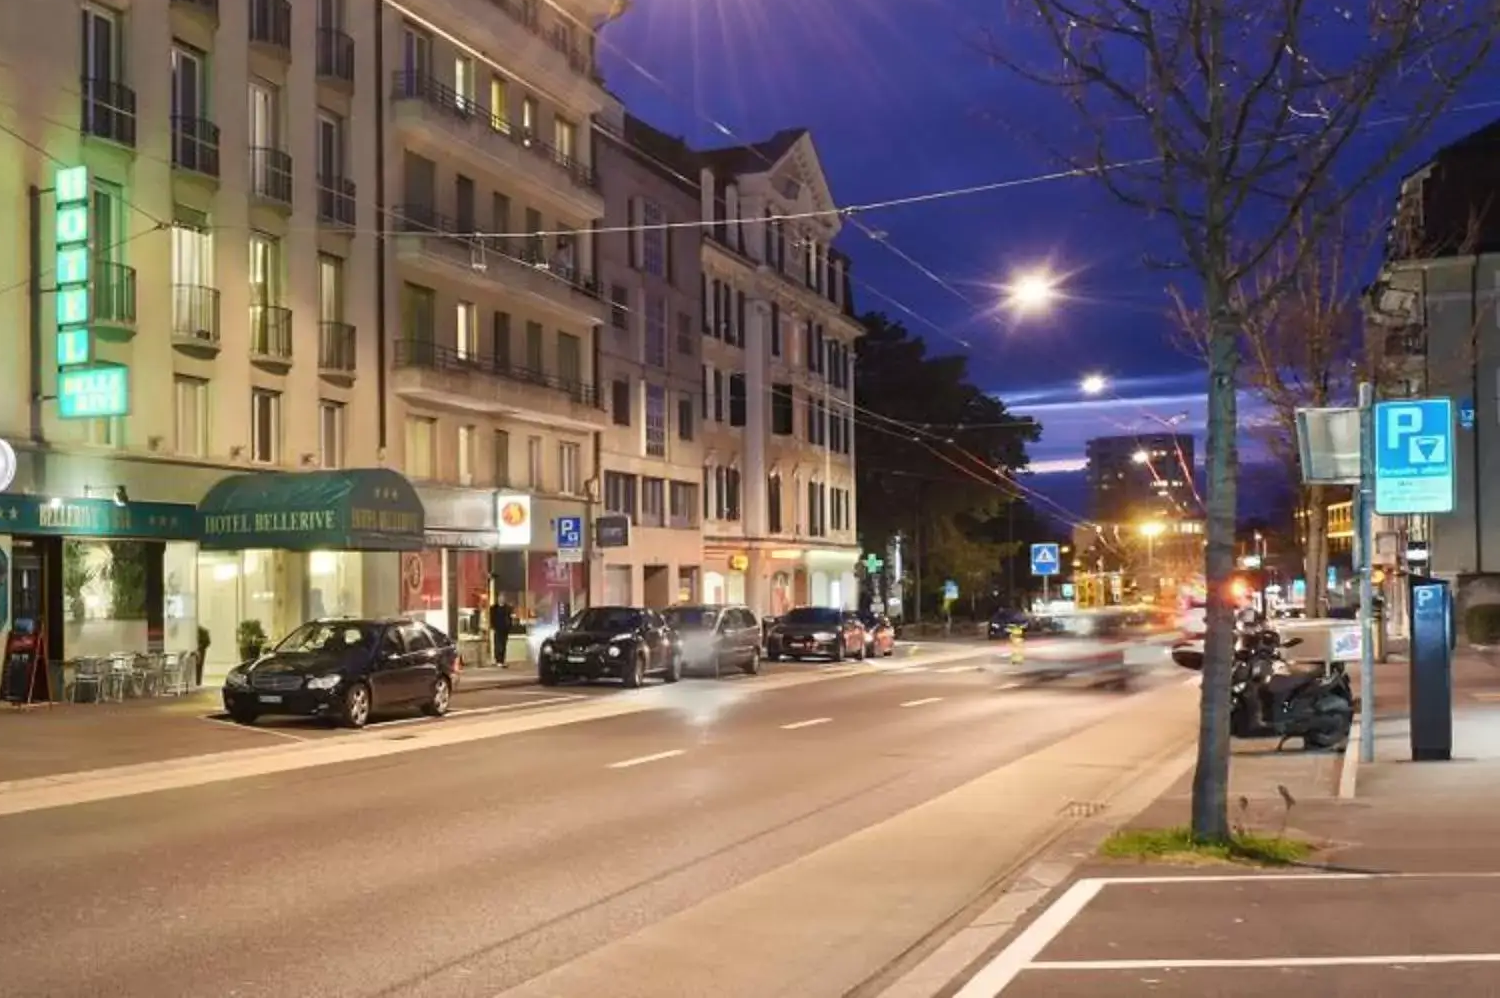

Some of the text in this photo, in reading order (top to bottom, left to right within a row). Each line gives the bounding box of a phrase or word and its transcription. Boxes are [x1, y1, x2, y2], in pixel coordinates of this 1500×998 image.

[58, 168, 87, 362] HOTEL
[1387, 407, 1423, 450] P
[205, 509, 336, 534] HOTEL BELLERIVE
[561, 519, 574, 536] P
[1417, 589, 1433, 606] P
